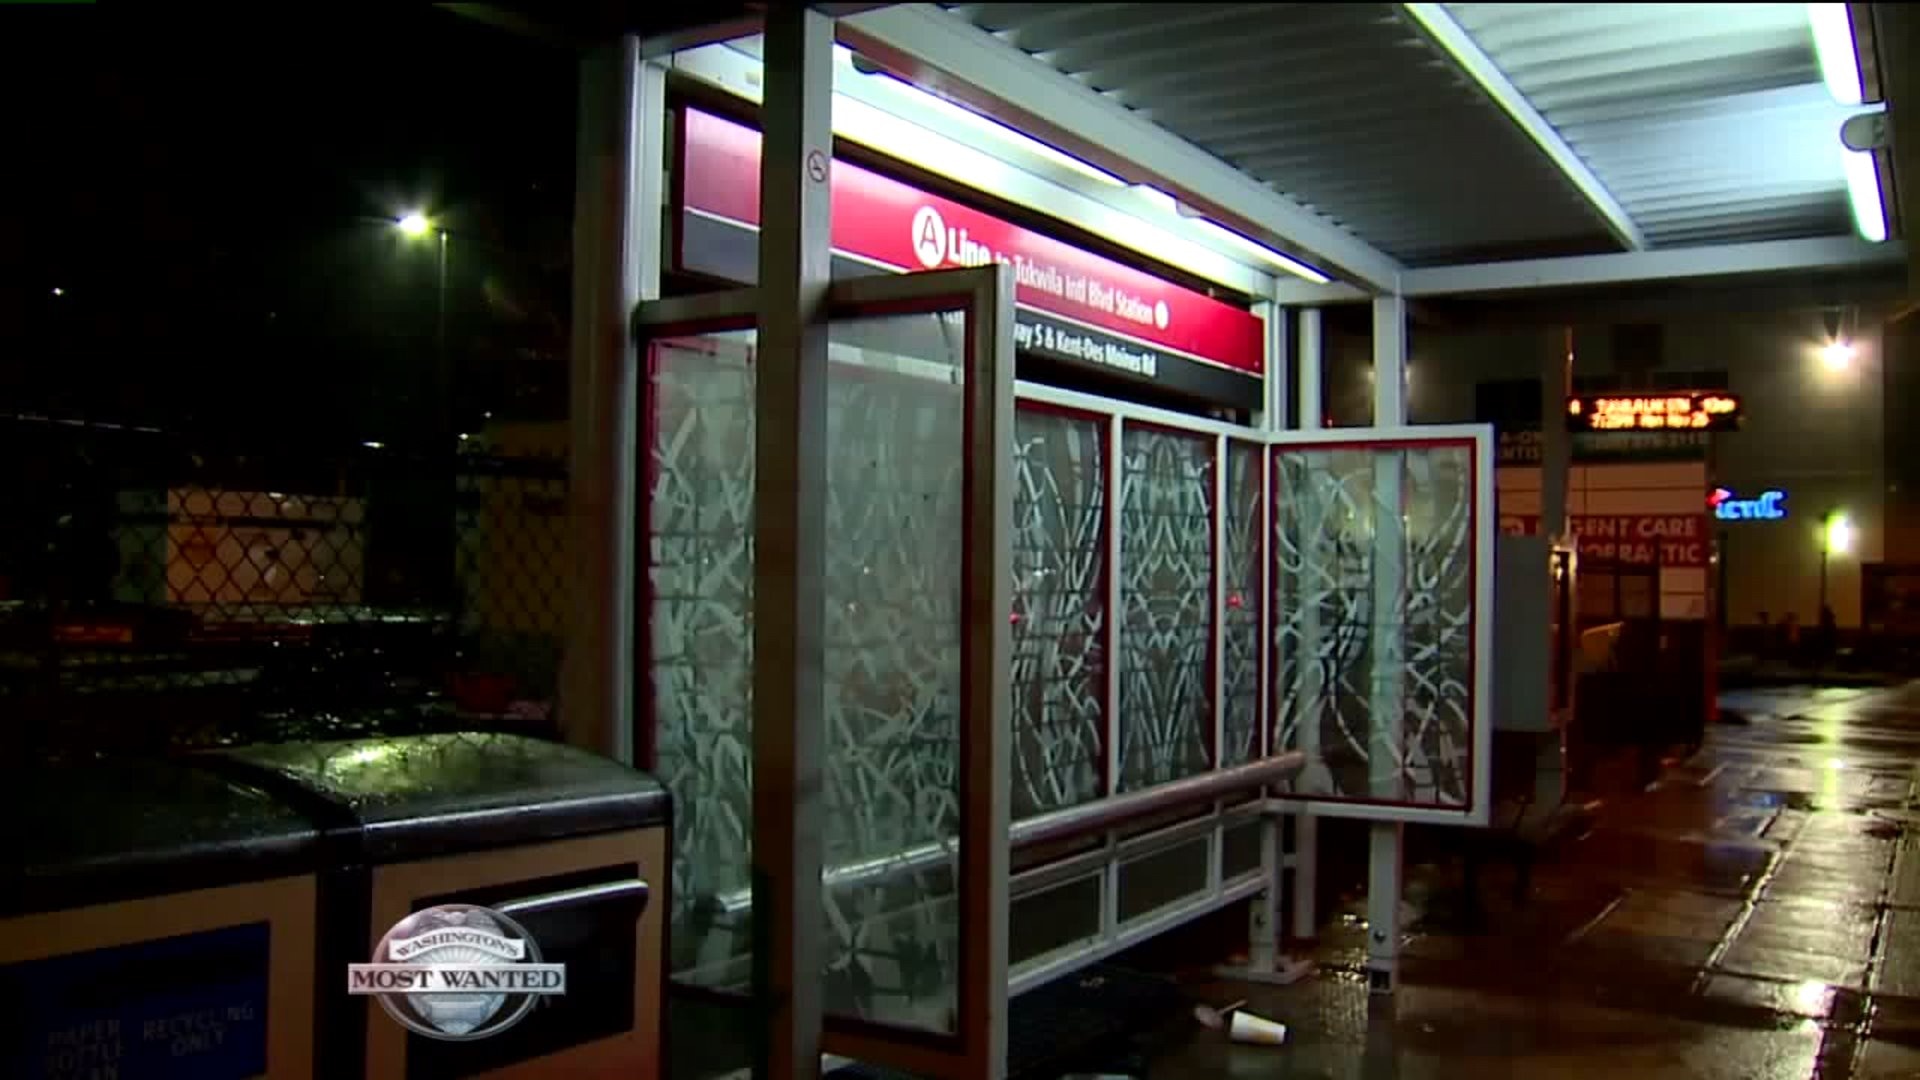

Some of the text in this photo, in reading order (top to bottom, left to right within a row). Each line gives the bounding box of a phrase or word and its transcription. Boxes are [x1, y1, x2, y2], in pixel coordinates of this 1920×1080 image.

[947, 227, 992, 266] Line
[1013, 255, 1063, 296] Tukwila
[1087, 278, 1114, 313] Blvd
[1115, 290, 1153, 325] Station
[1034, 323, 1043, 346] S
[1044, 326, 1055, 349] &
[1056, 330, 1104, 363] Kent-Des
[1105, 343, 1141, 372] Moines
[1142, 353, 1157, 377] Rd
[1637, 517, 1697, 536] CARE
